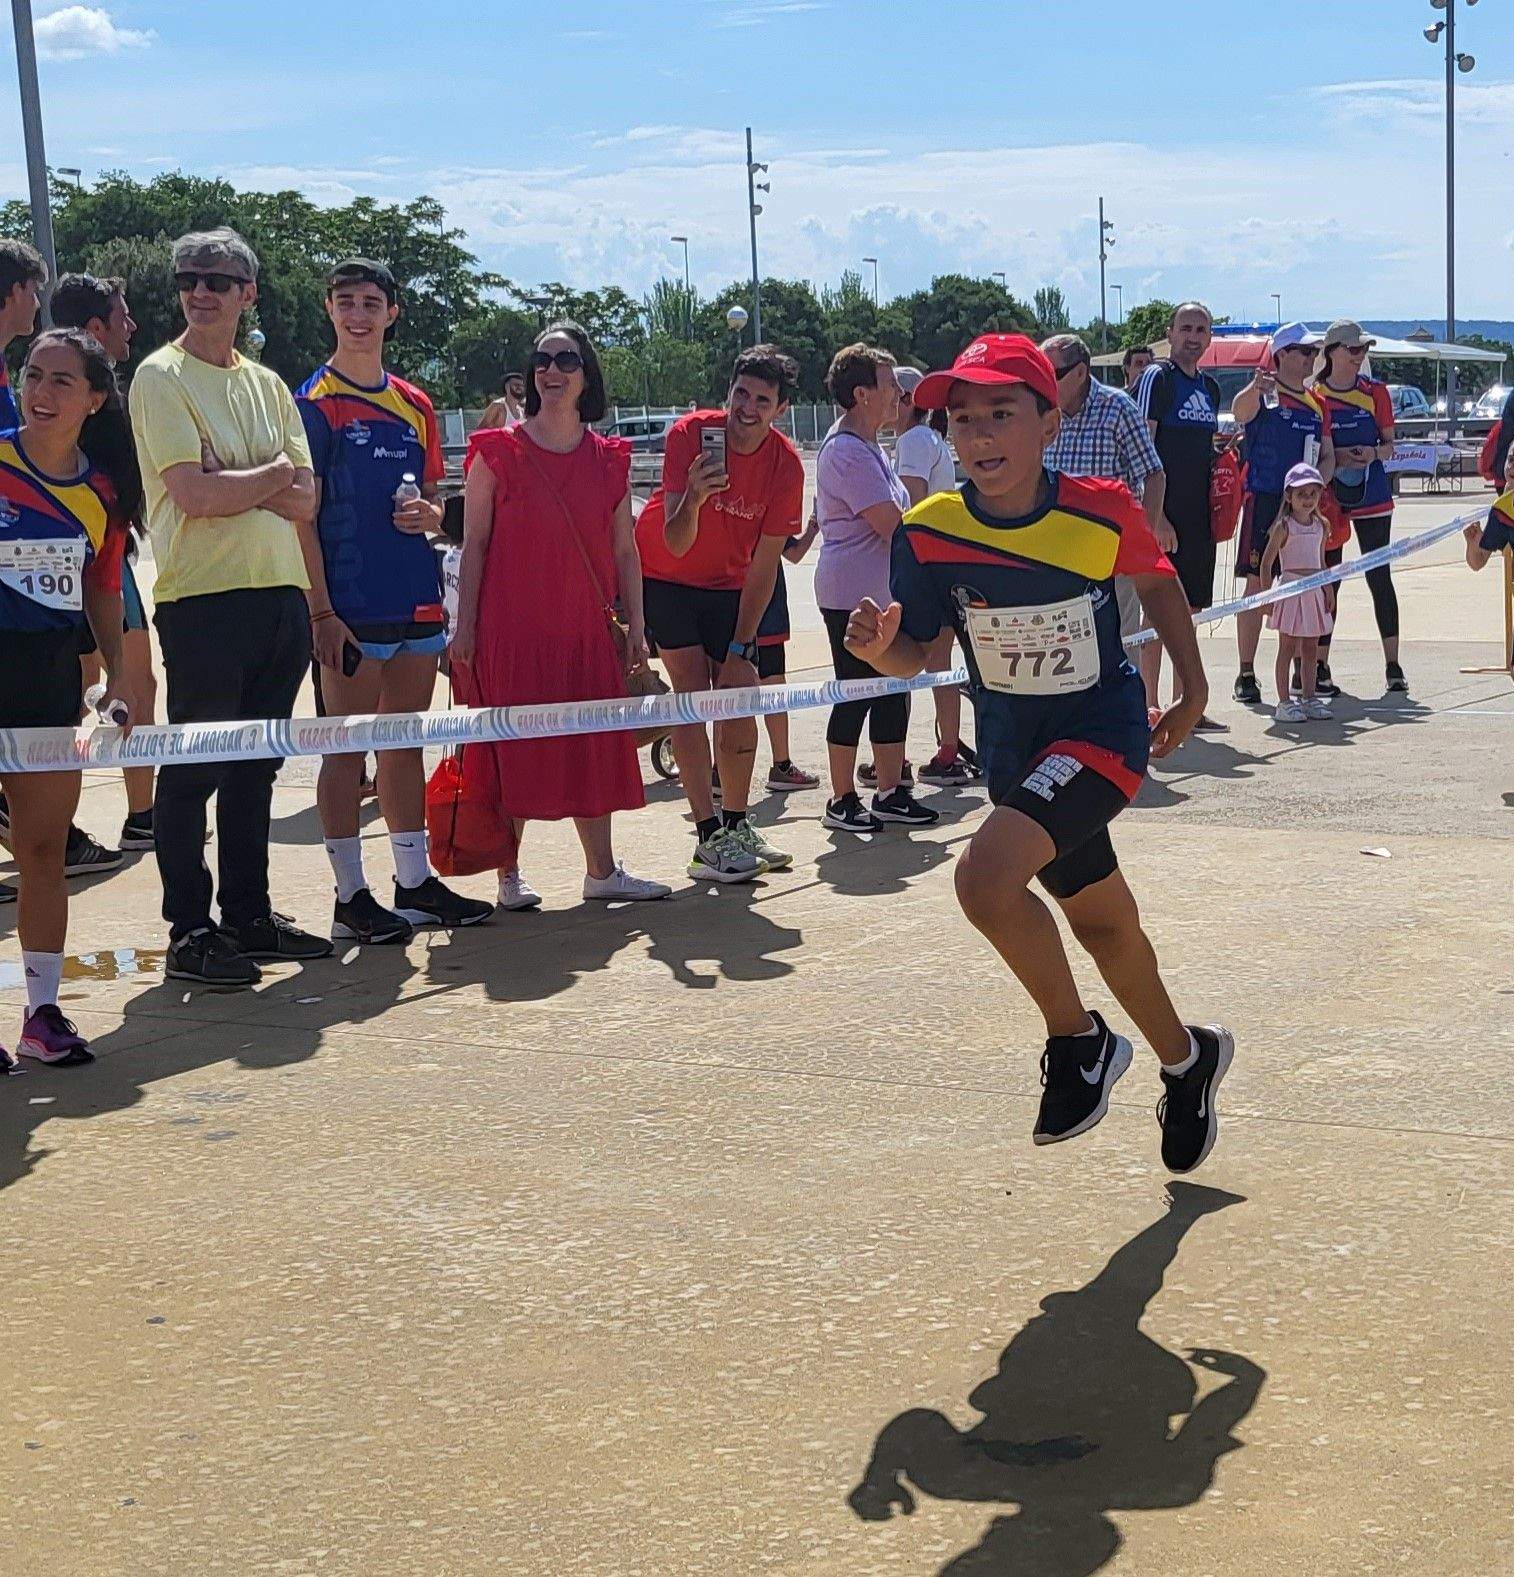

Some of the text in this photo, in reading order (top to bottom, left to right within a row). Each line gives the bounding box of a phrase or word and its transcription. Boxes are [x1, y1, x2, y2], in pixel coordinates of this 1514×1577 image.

[1178, 408, 1217, 423] adidas
[20, 574, 74, 596] 190
[999, 647, 1076, 678] 772
